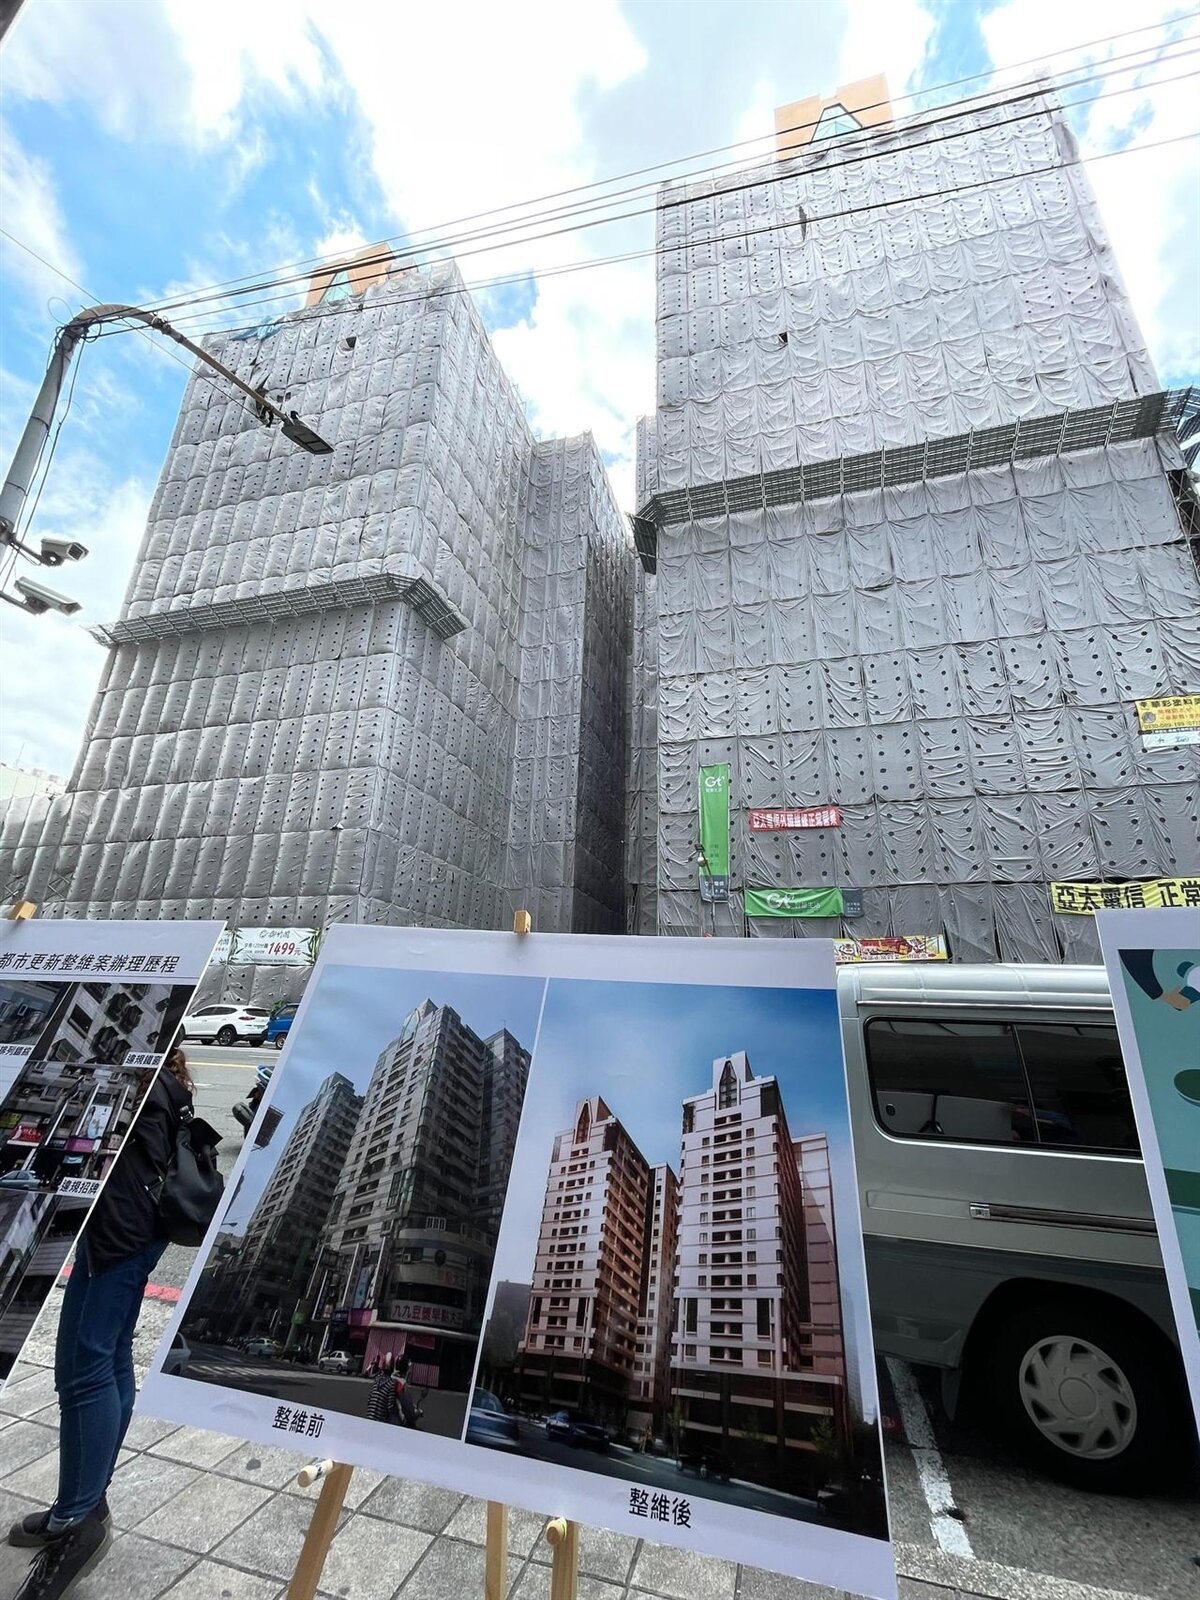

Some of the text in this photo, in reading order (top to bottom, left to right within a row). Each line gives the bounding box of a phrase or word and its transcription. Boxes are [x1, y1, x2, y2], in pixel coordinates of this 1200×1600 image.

[1055, 884, 1146, 911] 亞太電信
[0, 952, 180, 973] 都市更新整維案辦理歷程
[60, 1179, 101, 1195] 違規招牌
[272, 1406, 326, 1438] 整維前
[629, 1488, 691, 1528] 整維後
